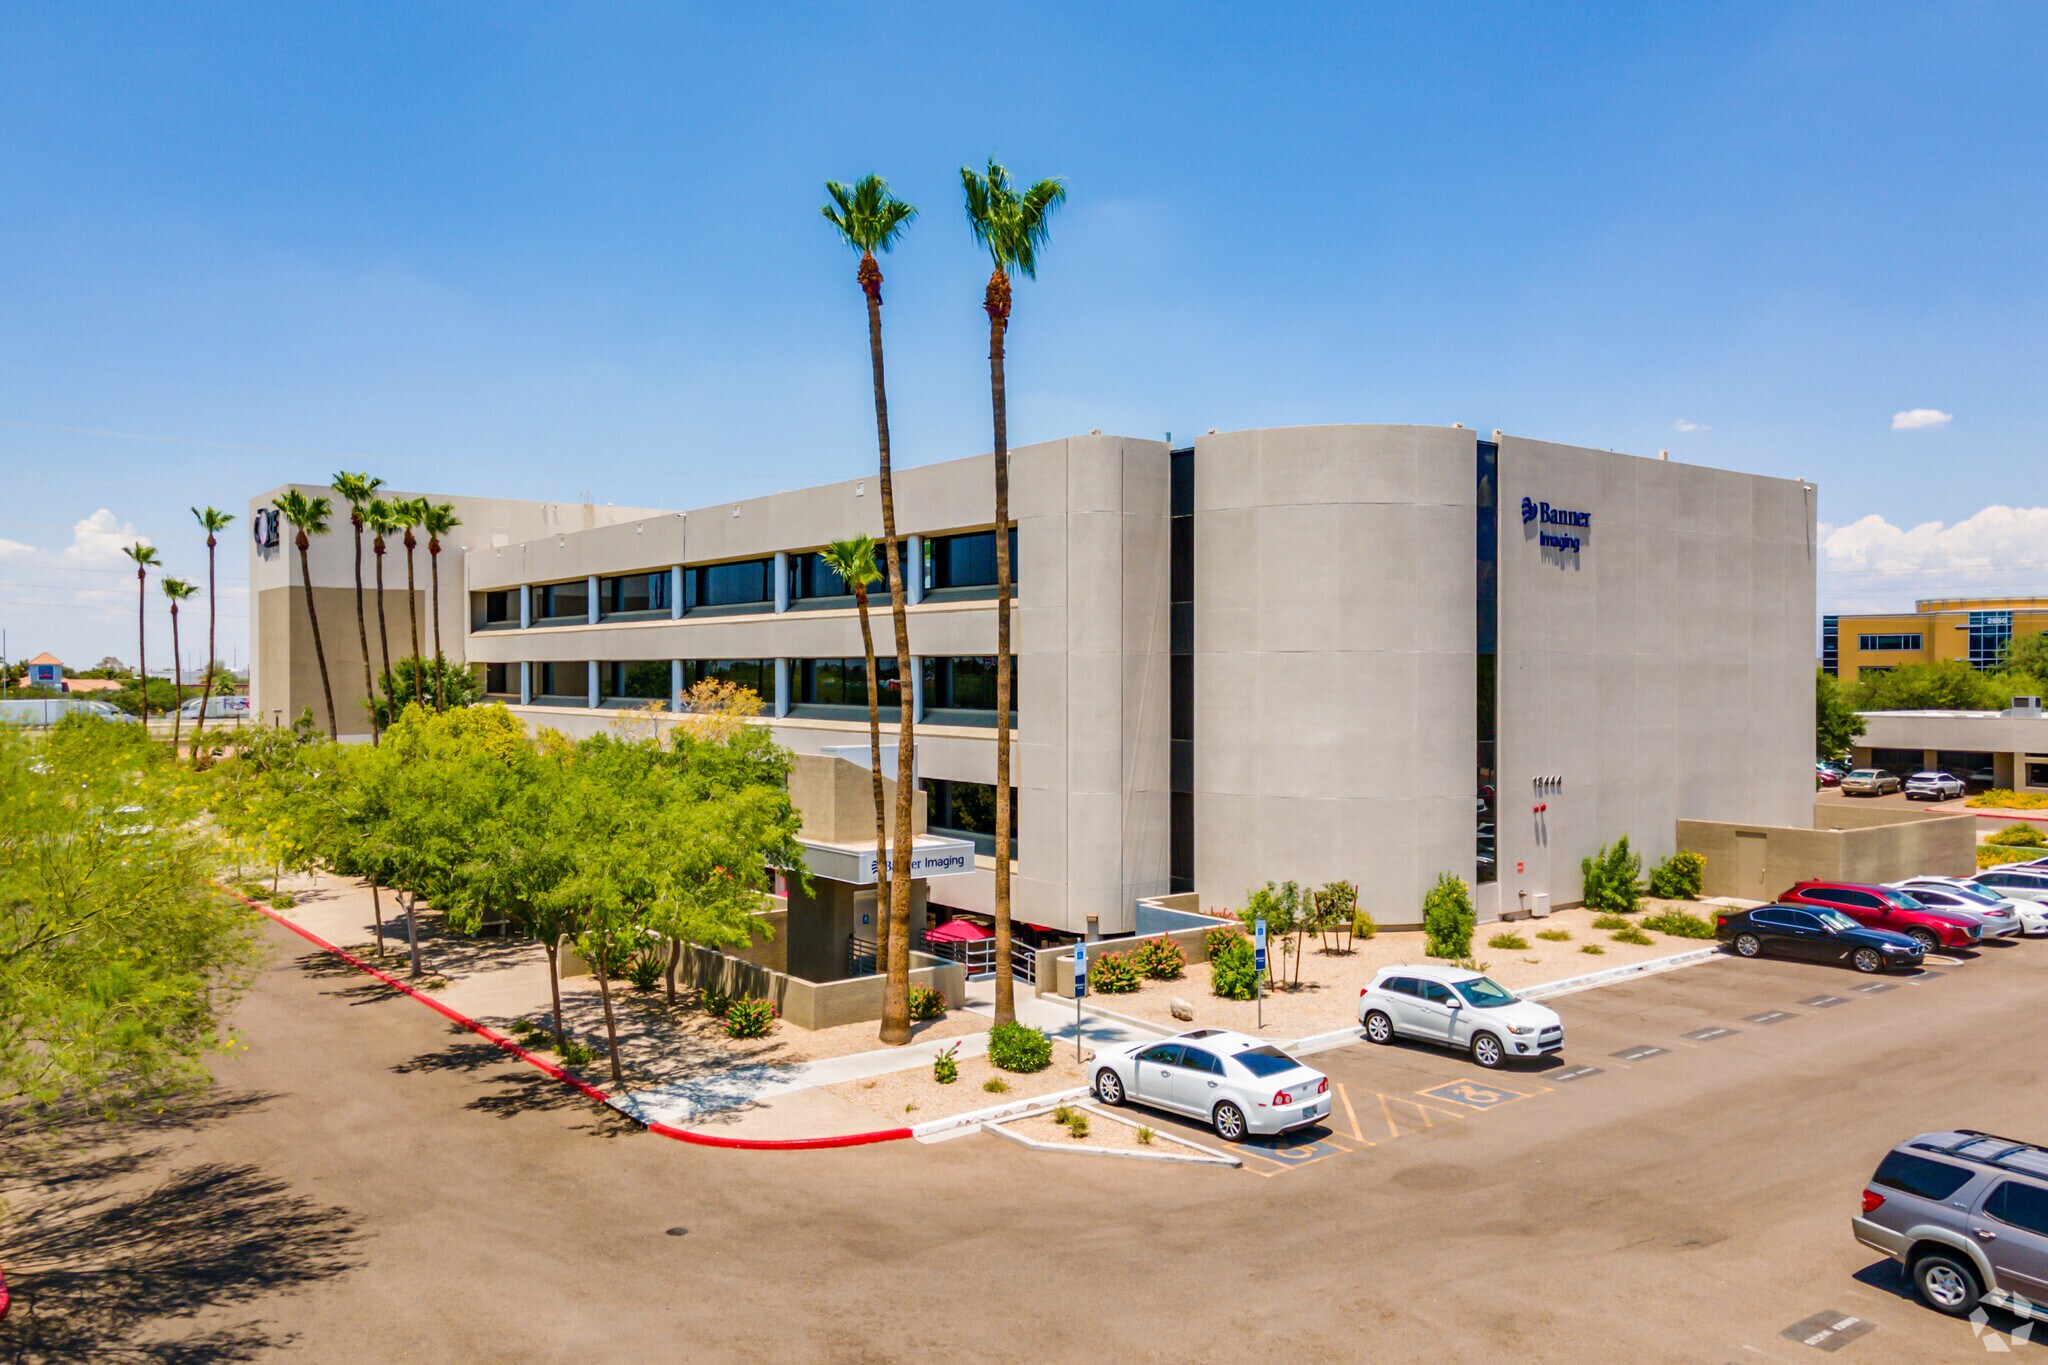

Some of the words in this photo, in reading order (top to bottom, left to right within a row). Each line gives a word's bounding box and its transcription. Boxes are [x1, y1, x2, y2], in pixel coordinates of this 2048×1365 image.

[1539, 502, 1591, 527] Banner
[1540, 531, 1580, 553] Imaging
[1532, 775, 1562, 788] 18444
[885, 860, 921, 872] Ber
[924, 855, 965, 869] Imaging
